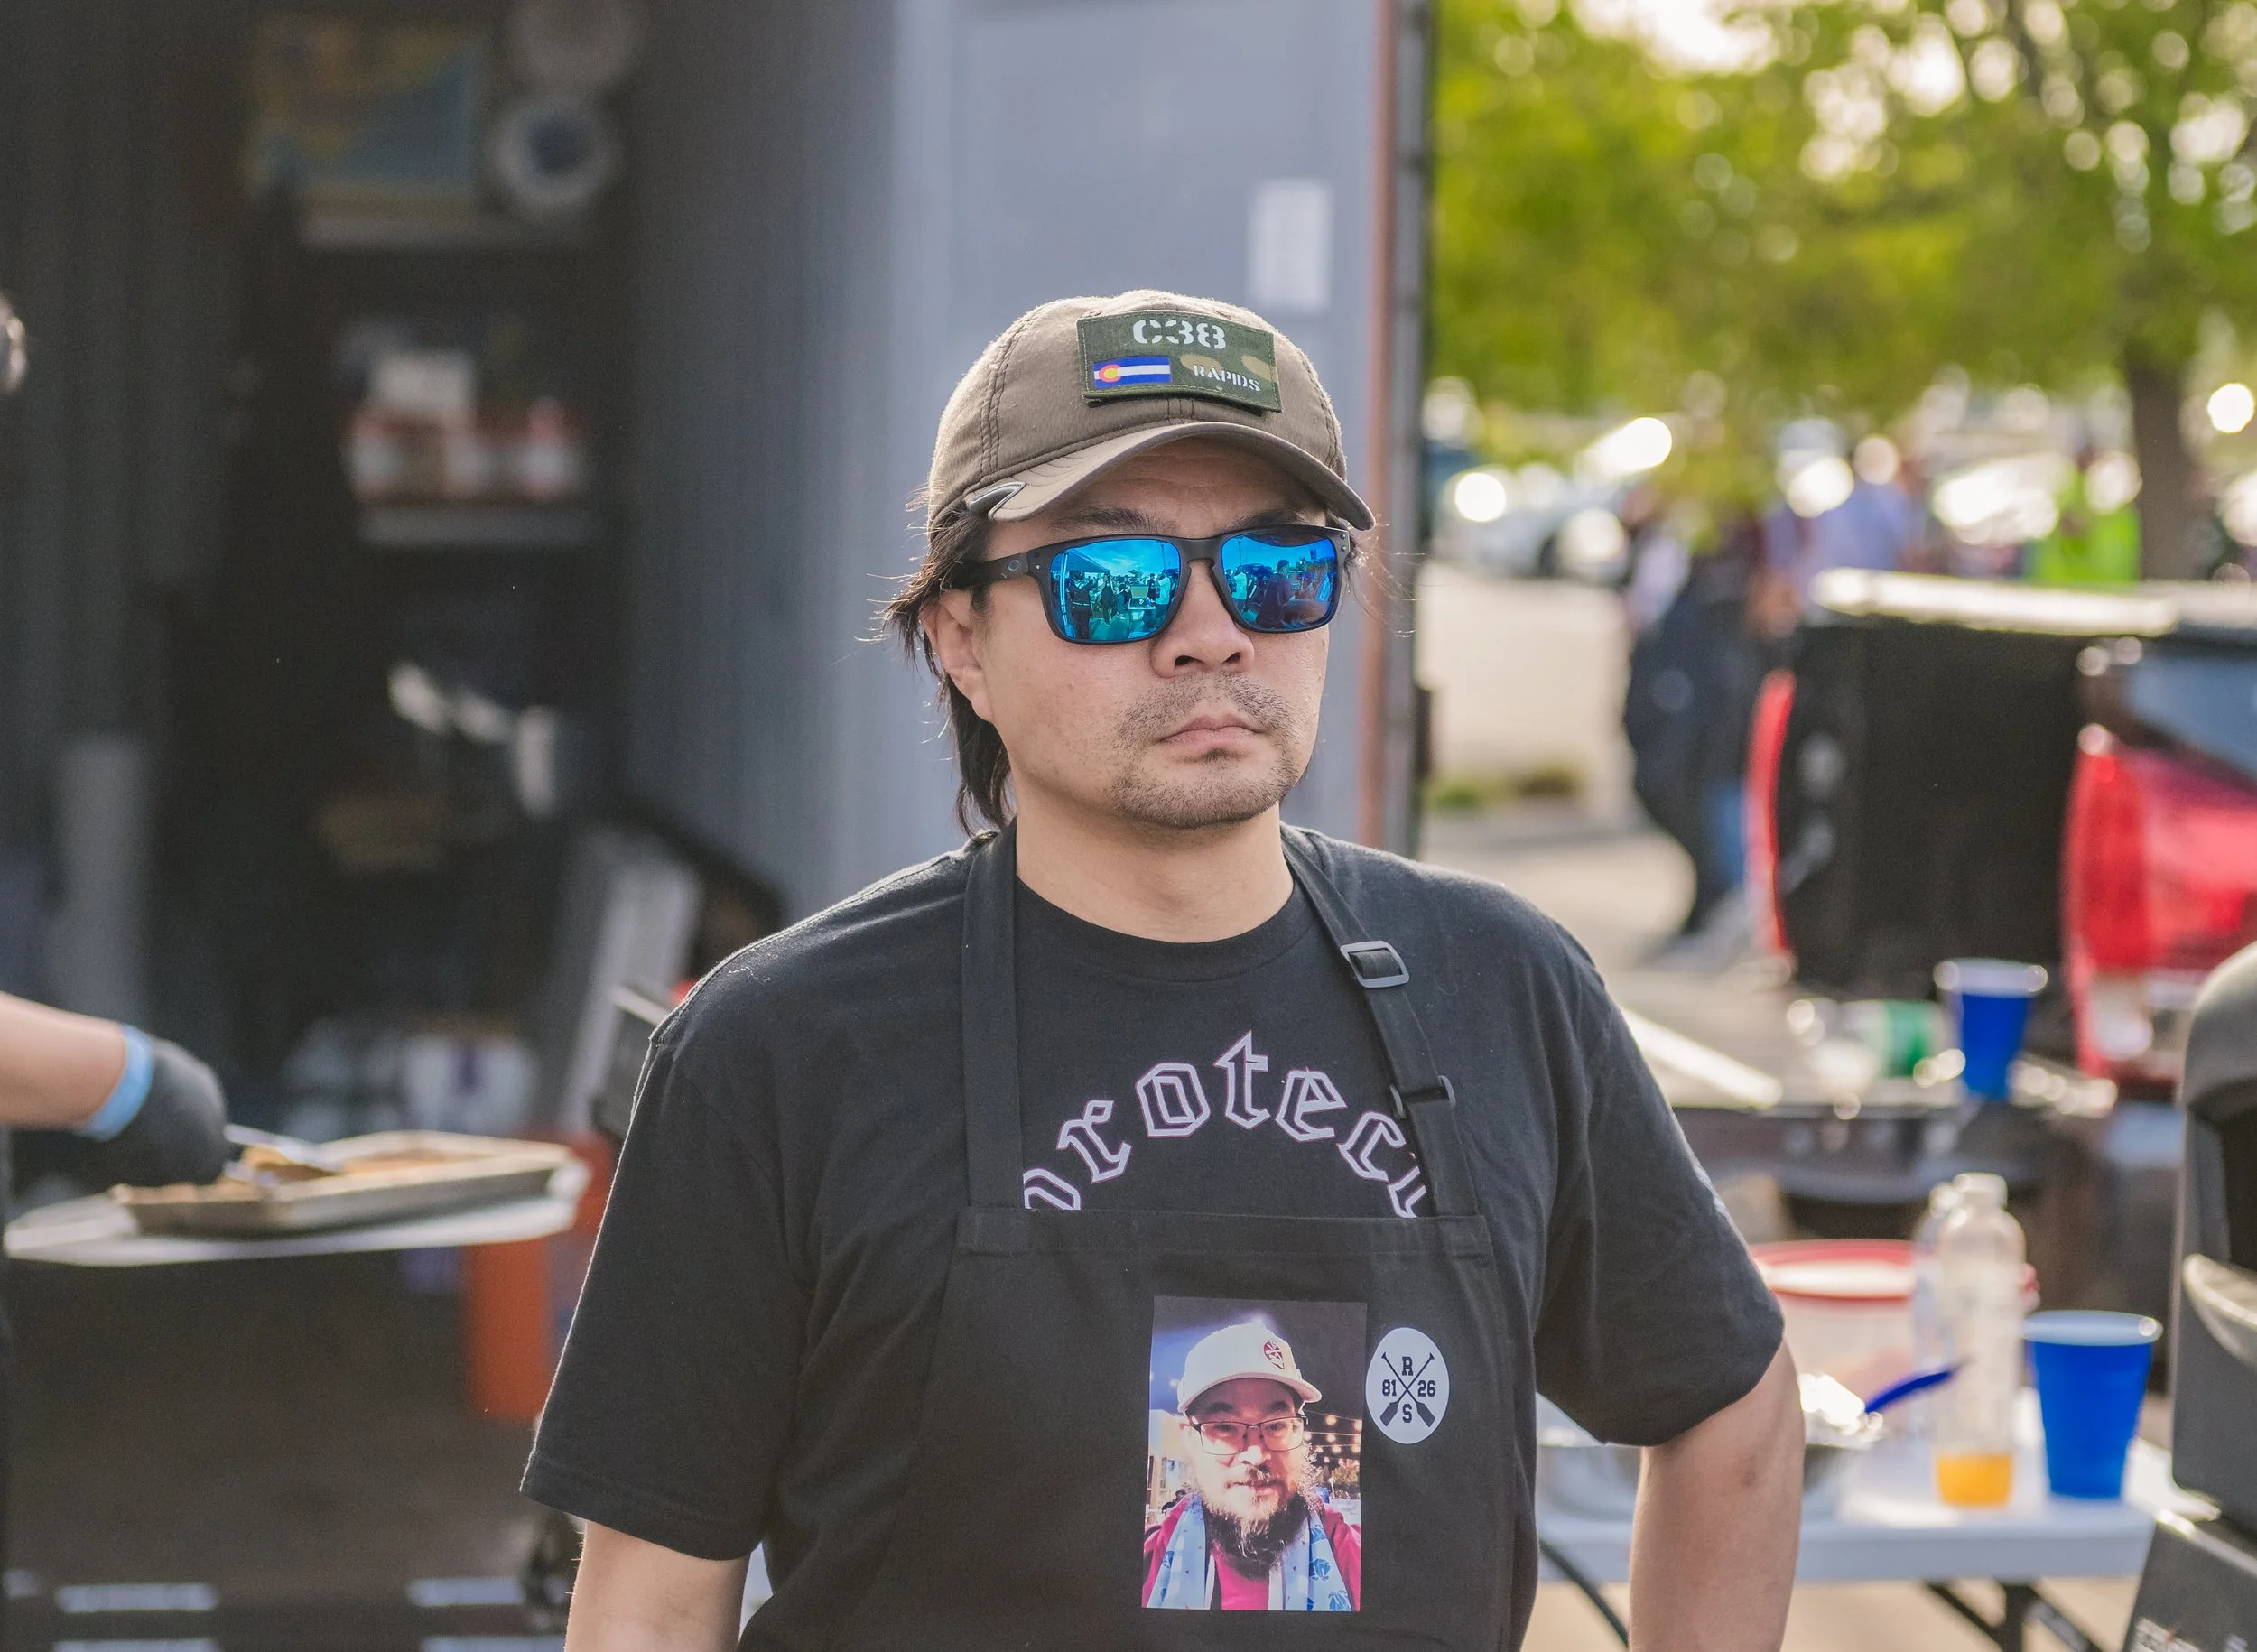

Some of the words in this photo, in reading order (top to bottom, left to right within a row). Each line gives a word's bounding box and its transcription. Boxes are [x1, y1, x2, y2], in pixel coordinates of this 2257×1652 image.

[1132, 319, 1226, 350] C38
[1193, 364, 1261, 392] RAPIDS
[1023, 1029, 1426, 1219] rotec
[1401, 1356, 1414, 1376] R
[1381, 1379, 1397, 1397] 81
[1417, 1379, 1436, 1397] 26
[1402, 1403, 1413, 1424] S
